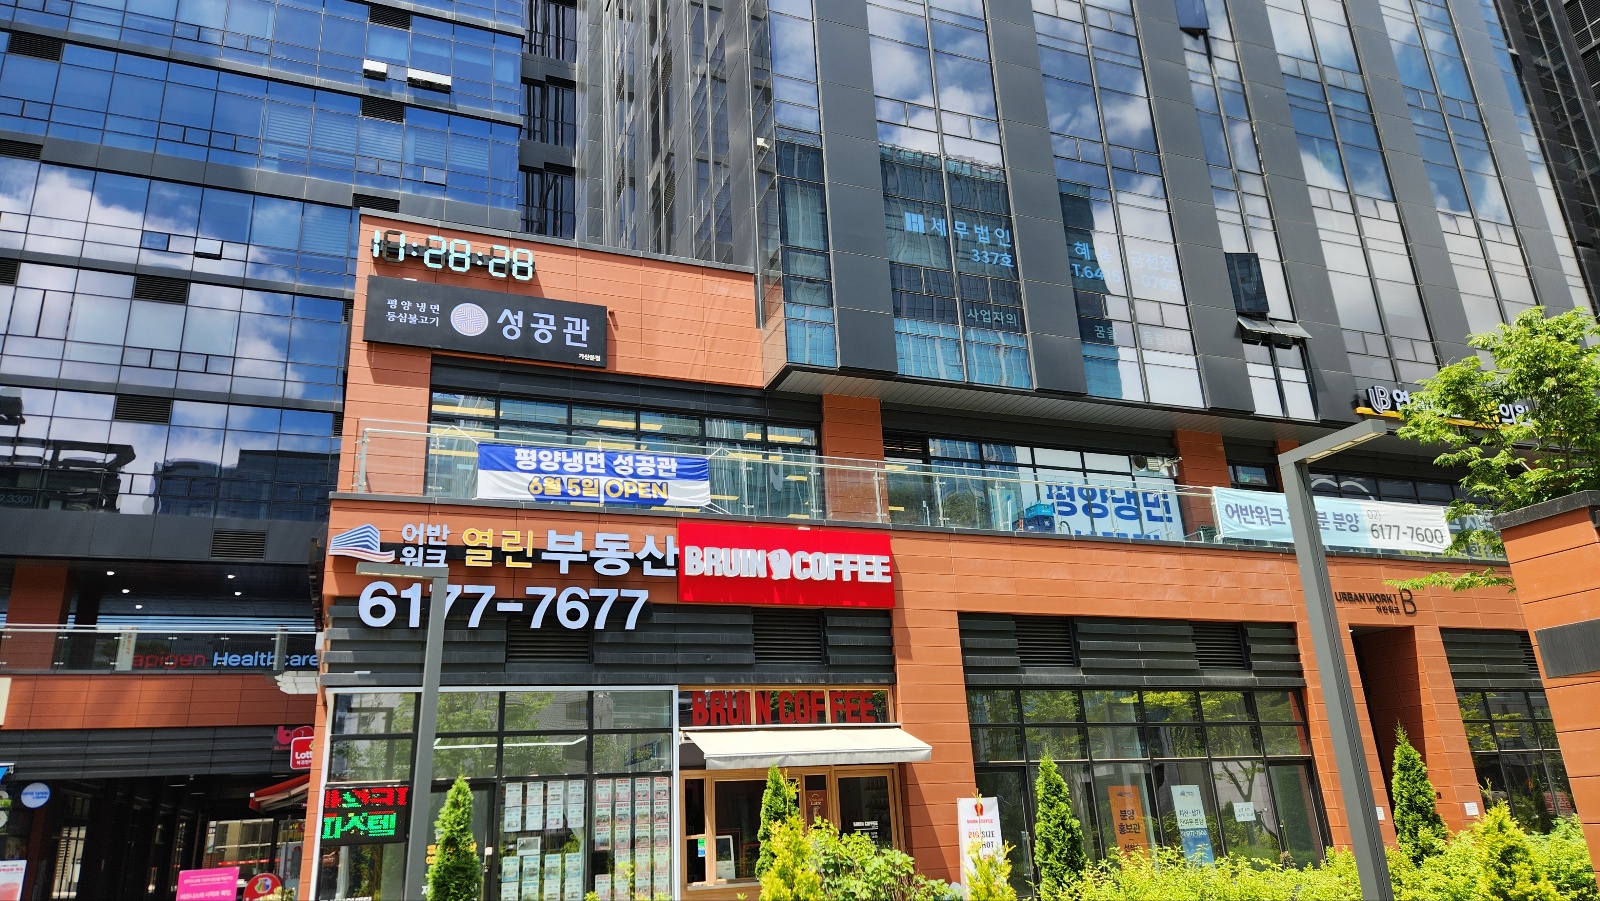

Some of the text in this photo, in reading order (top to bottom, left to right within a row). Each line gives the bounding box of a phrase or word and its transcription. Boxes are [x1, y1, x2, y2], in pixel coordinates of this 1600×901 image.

[372, 229, 533, 281] 11:28:28
[971, 248, 1015, 269] 337호
[385, 311, 440, 327] 등심불고기
[497, 308, 591, 348] 성공관
[967, 308, 1188, 349] 사업자의 꿈을 돌봅니다
[514, 448, 678, 477] 평양냉면 성공관
[527, 476, 669, 500] 6월 5일 OPEN
[1046, 481, 1173, 523] 평양냉면
[1225, 503, 1284, 528] 어반워크
[1333, 511, 1360, 533] 분양
[1366, 509, 1381, 522] 02)
[401, 523, 450, 546] 어반
[1370, 523, 1444, 544] 6177-7600
[399, 546, 449, 568] 워크
[462, 527, 680, 577] 열린 부동산
[684, 545, 892, 583] BRUIN COFFEE
[357, 580, 649, 631] 6177-7677
[1334, 591, 1366, 603] URBAN
[1366, 593, 1393, 604] WORK
[1399, 588, 1417, 615] B
[692, 690, 876, 726] BRUIN COFFEE
[1120, 809, 1135, 820] 분양
[981, 830, 995, 838] SIZE
